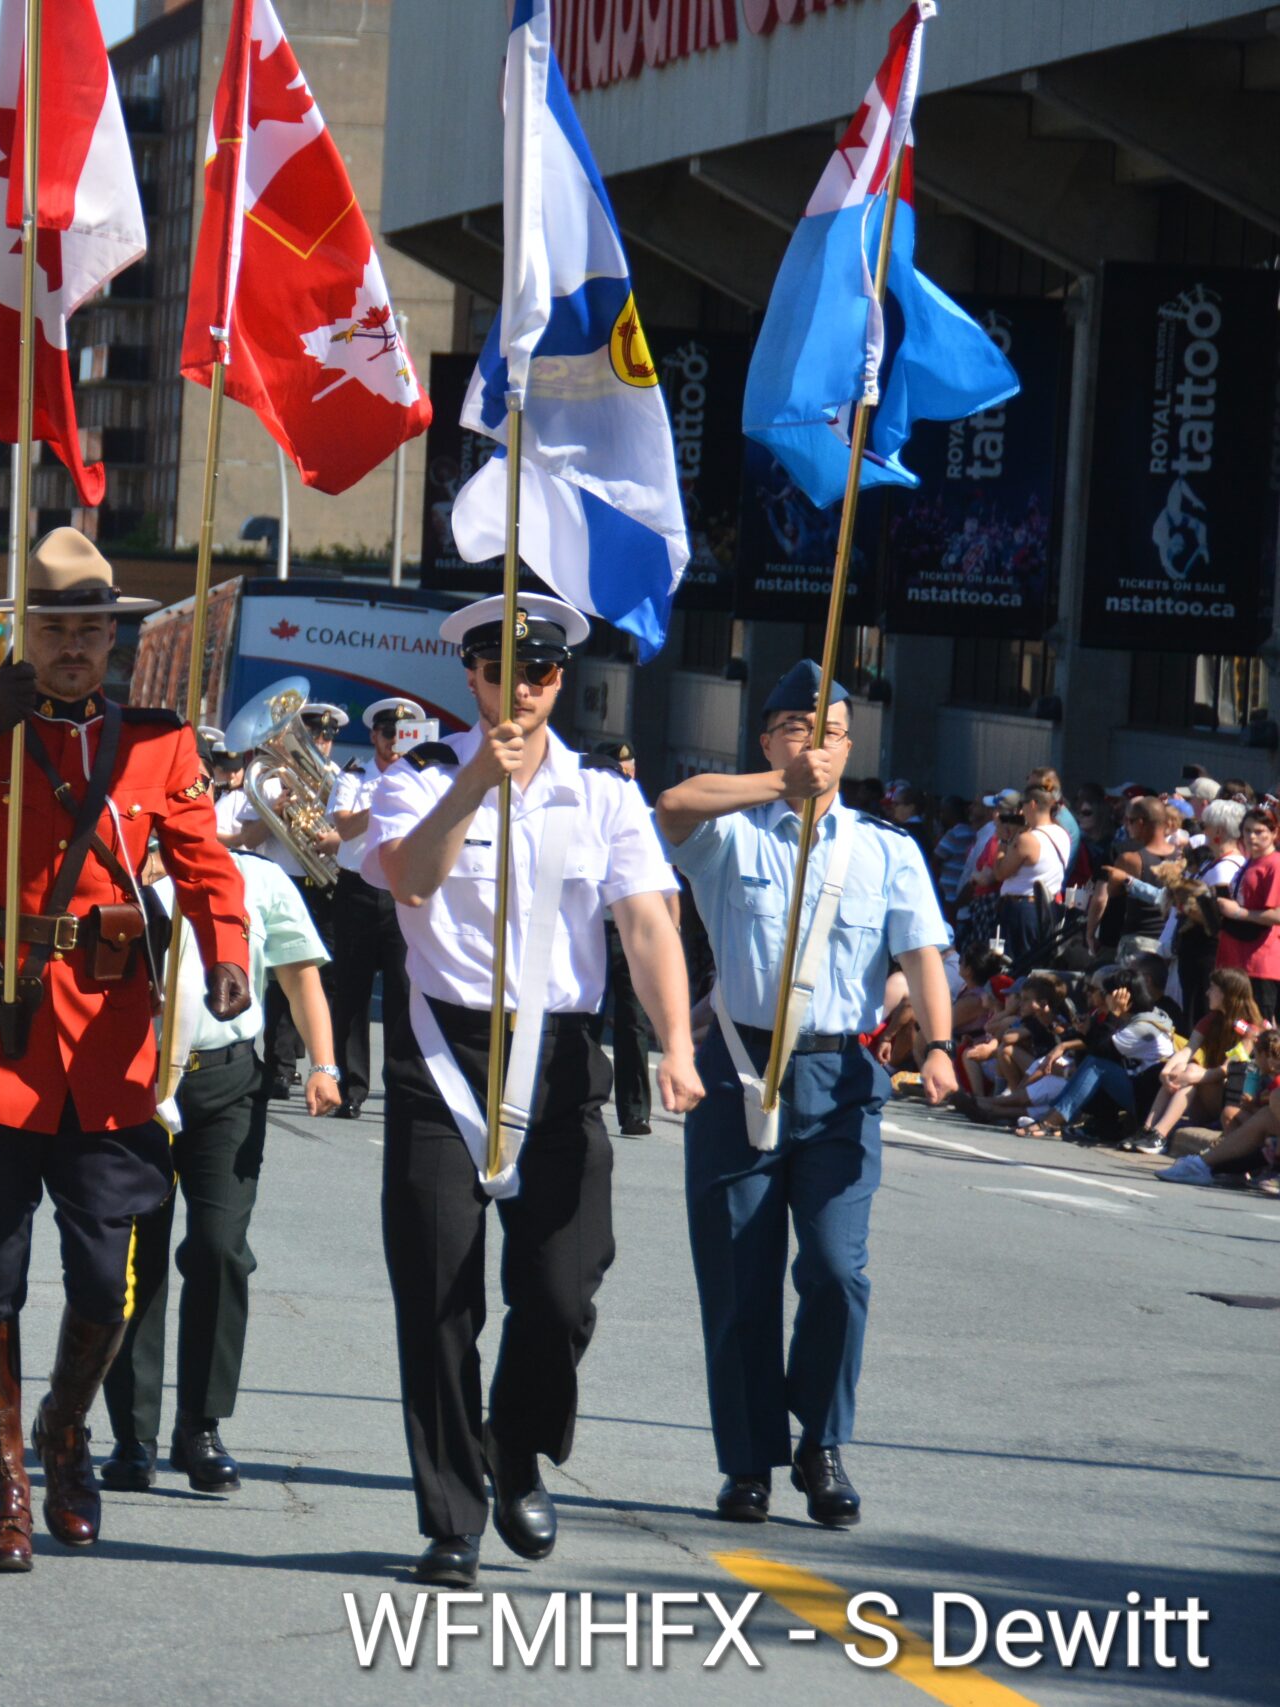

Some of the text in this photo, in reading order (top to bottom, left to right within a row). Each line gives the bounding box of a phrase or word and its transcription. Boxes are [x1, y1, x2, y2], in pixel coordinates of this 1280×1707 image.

[1171, 298, 1221, 475] tattoo
[1149, 392, 1170, 473] ROYAL
[946, 419, 965, 479] ROYA
[754, 576, 858, 596] nstattooa
[919, 571, 1014, 585] TICKETS ON SALE
[1118, 577, 1226, 594] TICKETS ON SALE
[907, 585, 1022, 607] nstattoo.ca
[1105, 595, 1236, 618] nstattoo.ca
